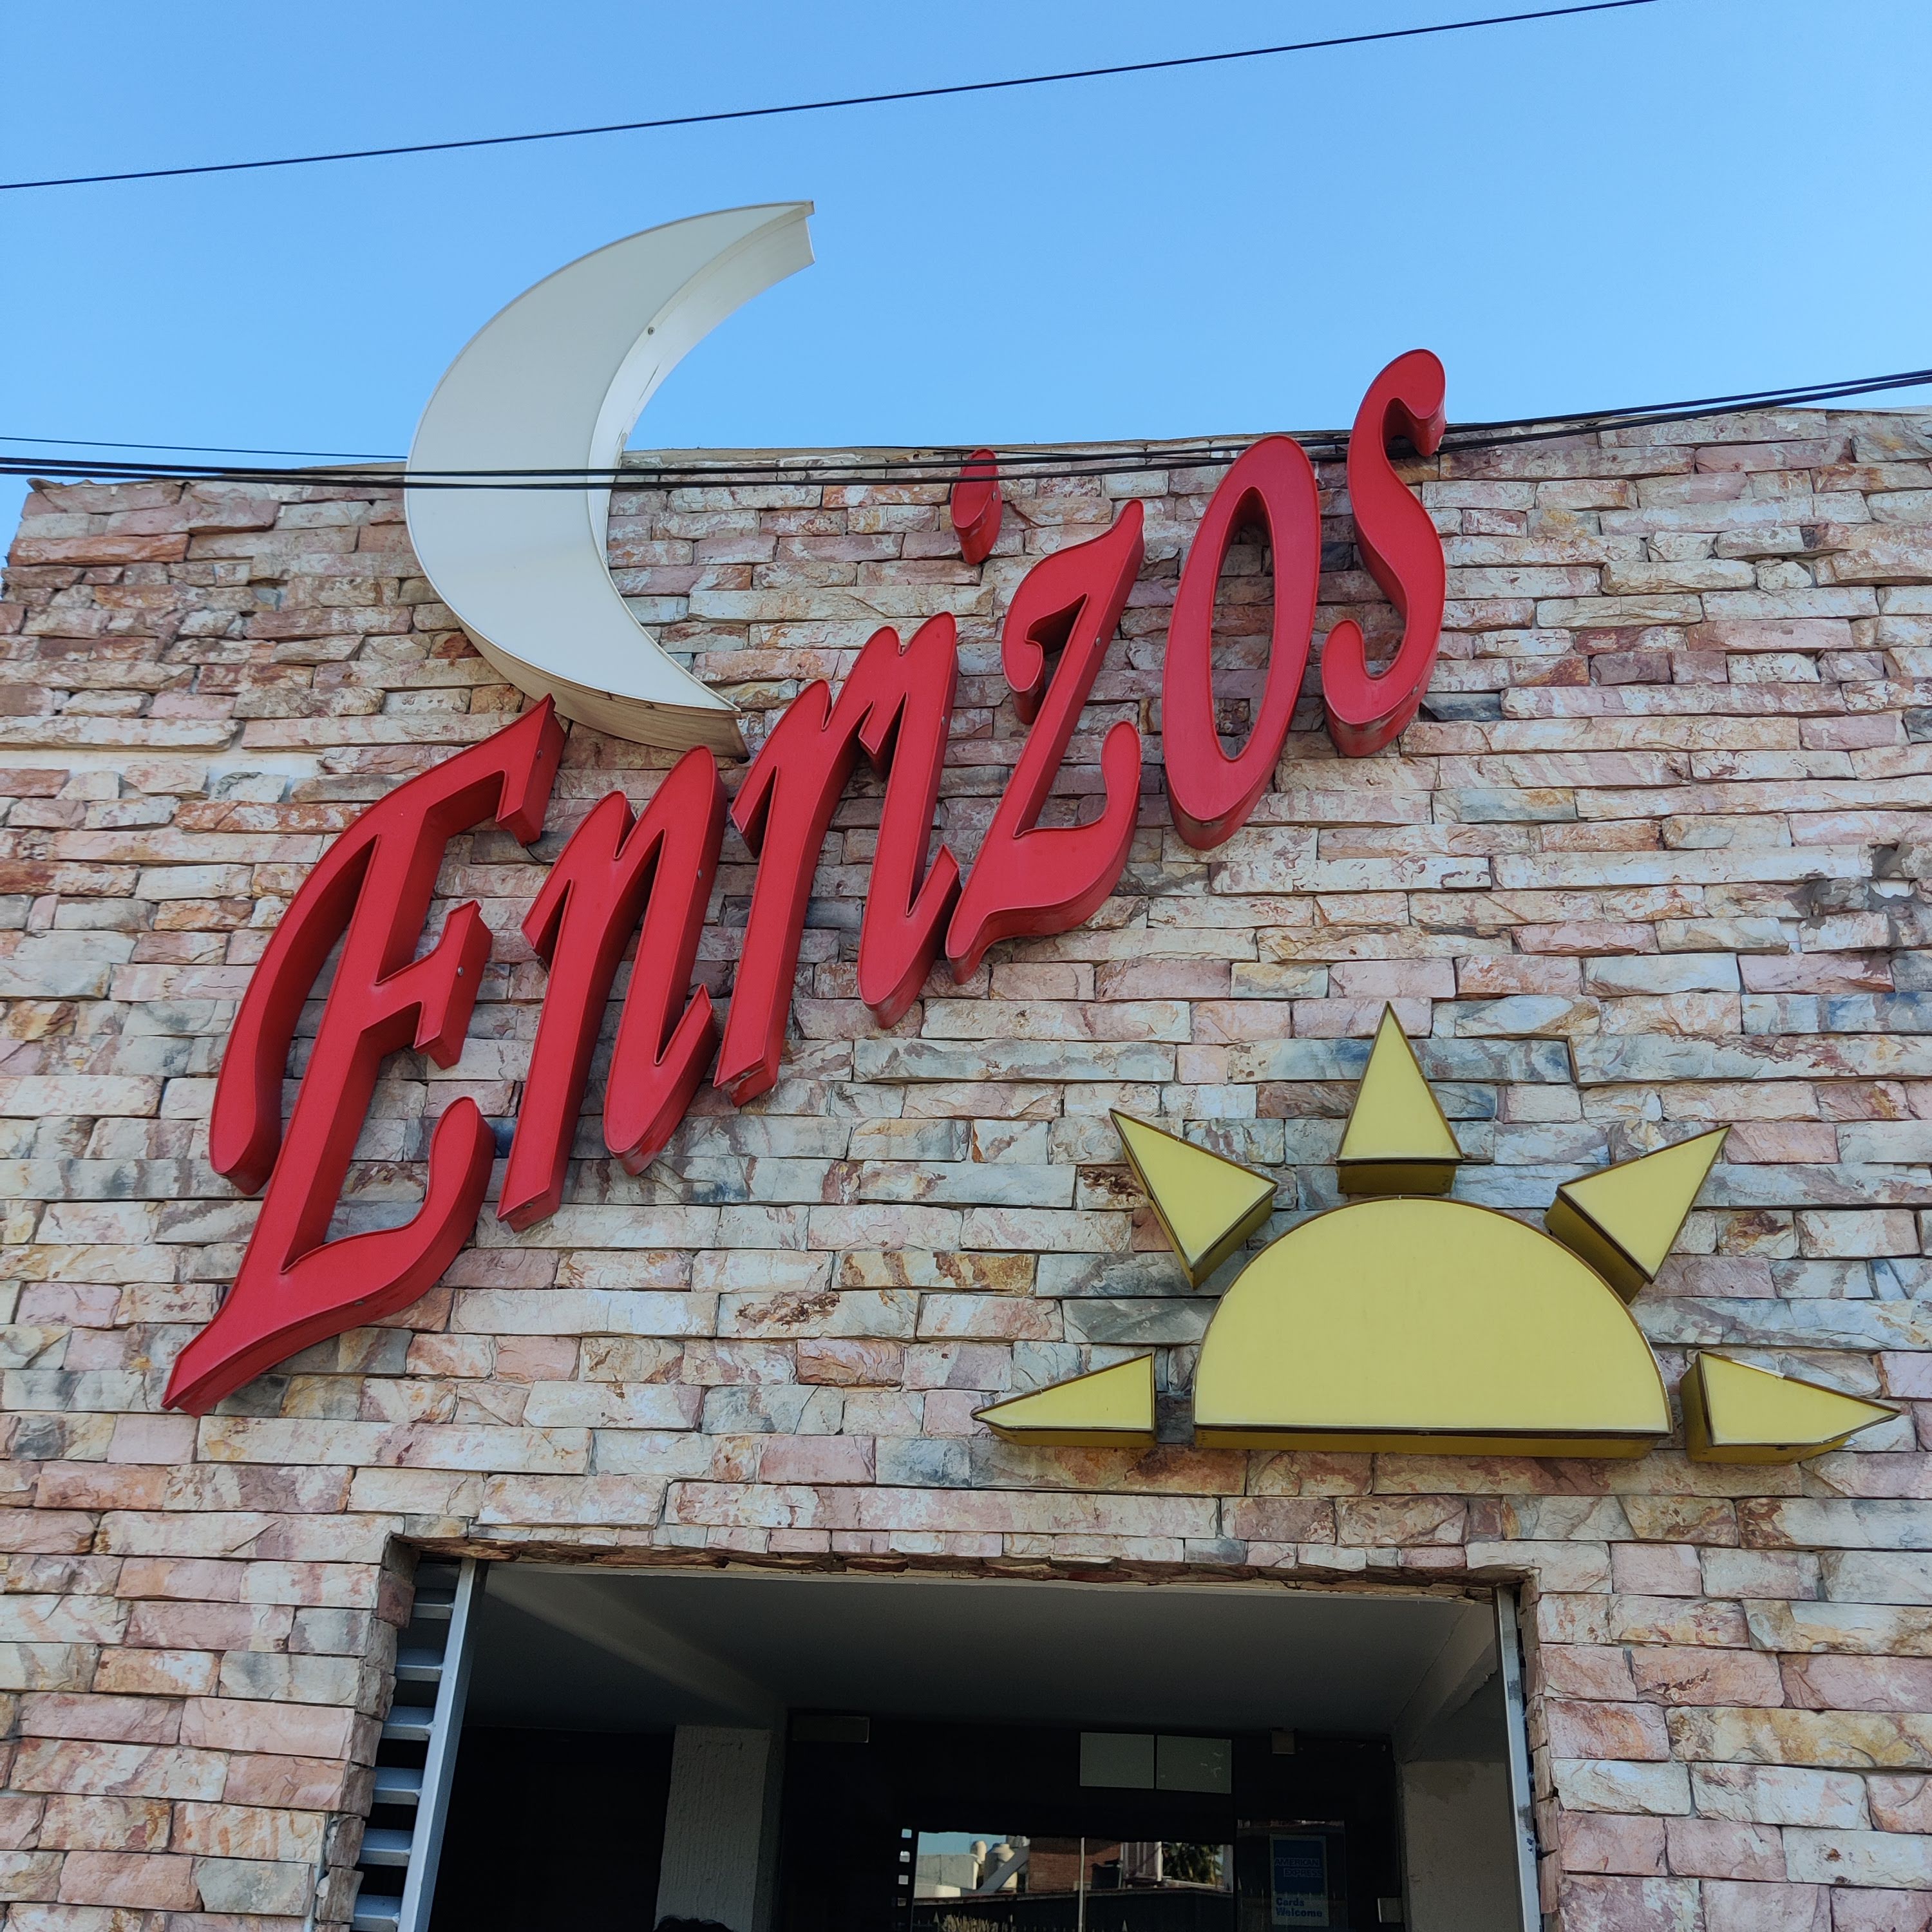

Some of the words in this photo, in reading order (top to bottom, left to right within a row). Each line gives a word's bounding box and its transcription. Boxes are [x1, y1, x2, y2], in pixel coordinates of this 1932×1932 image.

[1274, 1857, 1320, 1867] AMERICAN
[1283, 1868, 1323, 1878] EXPRESS
[1276, 1898, 1305, 1906] Cards
[1276, 1908, 1323, 1917] Welcome
